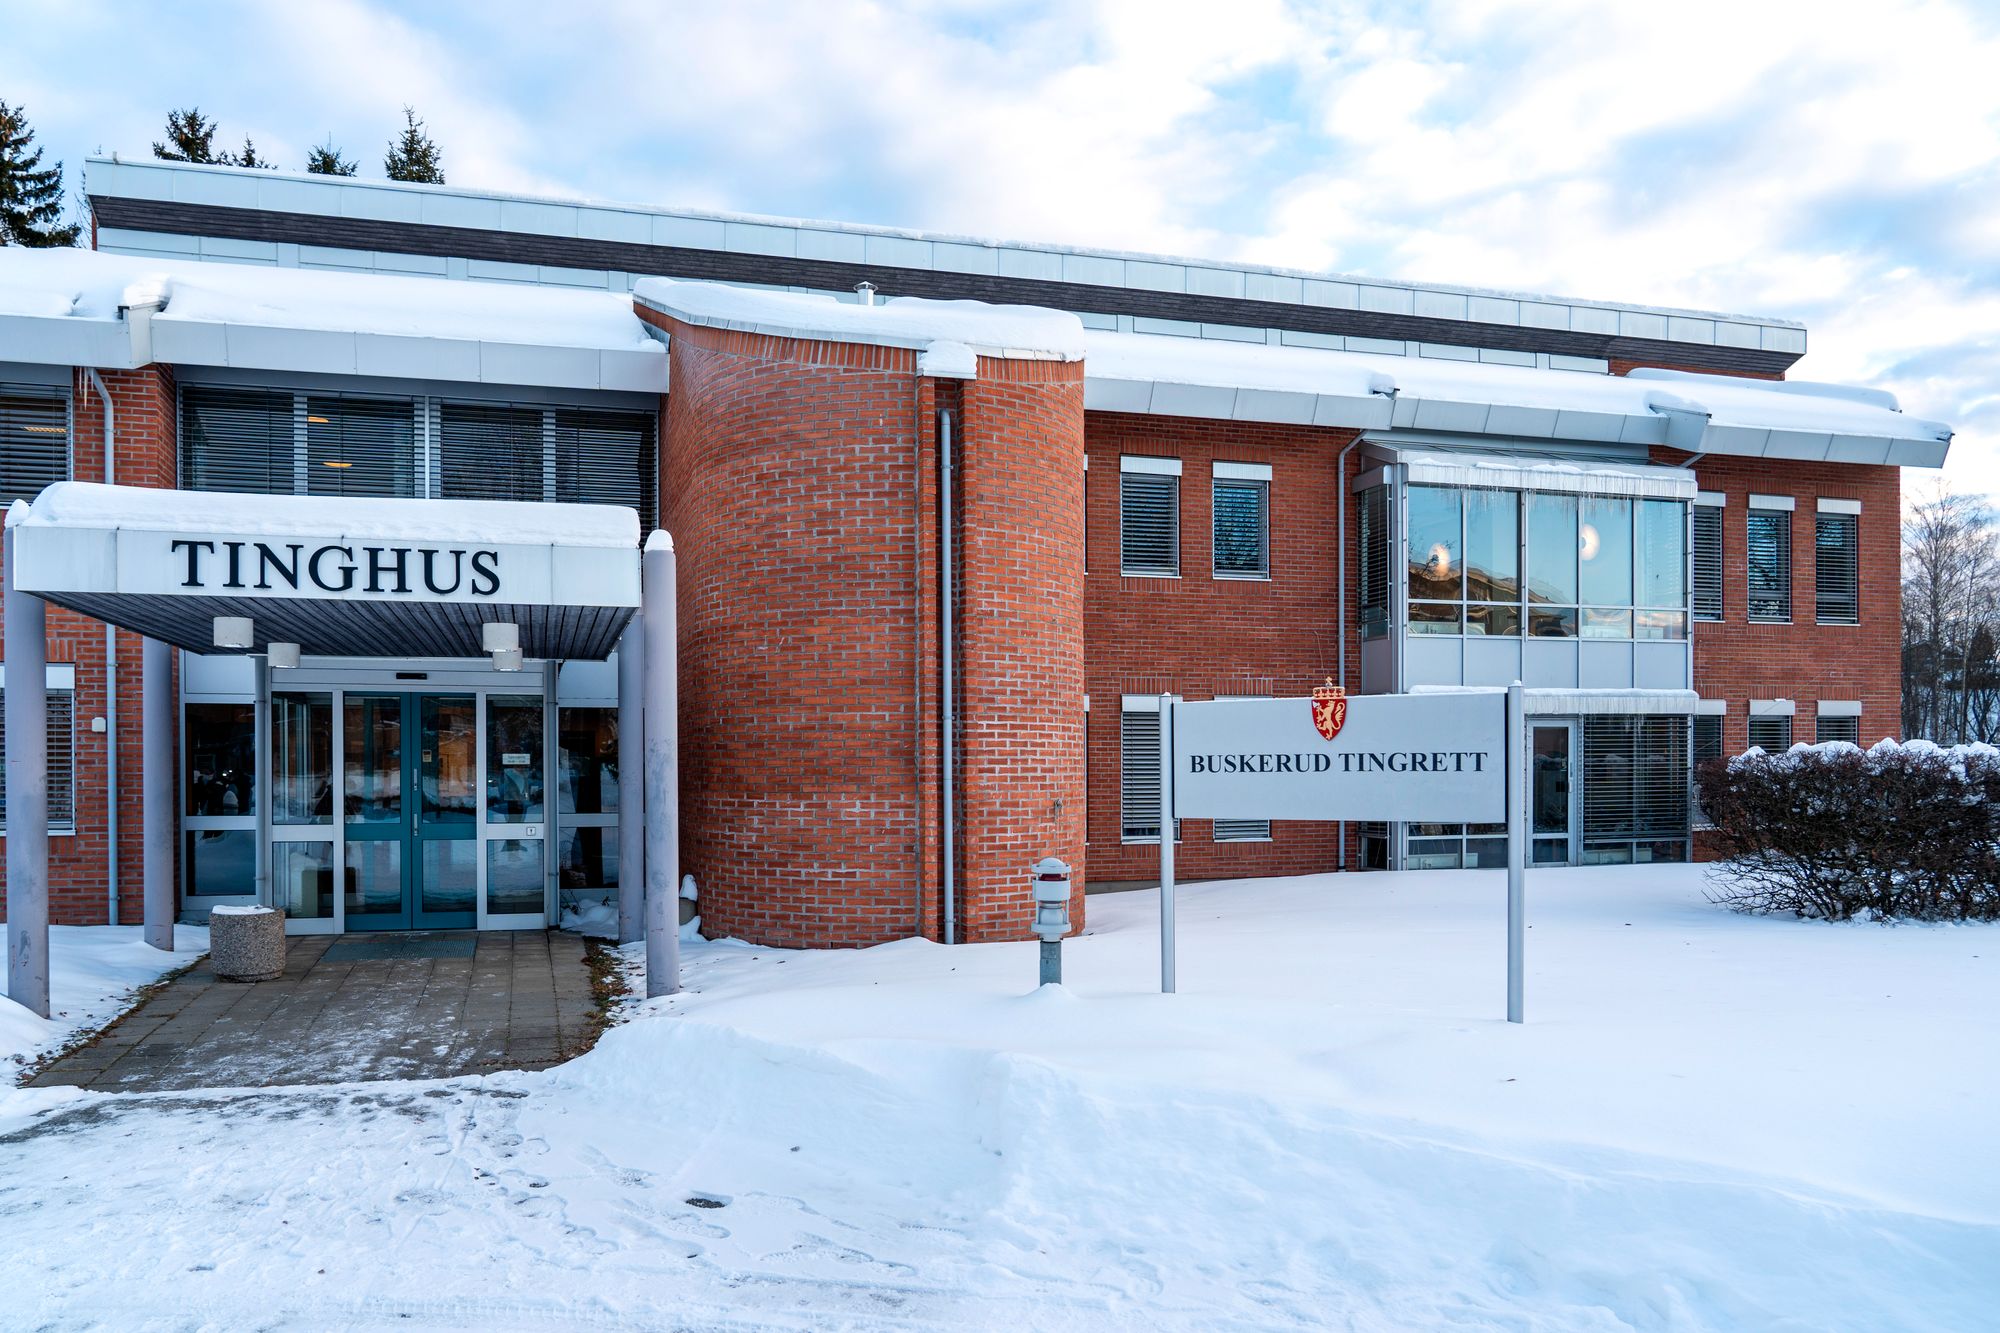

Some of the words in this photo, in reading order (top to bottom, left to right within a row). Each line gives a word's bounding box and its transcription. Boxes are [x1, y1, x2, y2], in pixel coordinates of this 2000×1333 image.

[171, 539, 501, 596] TINGHUS
[1190, 753, 1331, 774] BUSKERUD
[1338, 752, 1488, 773] TINGRETT
